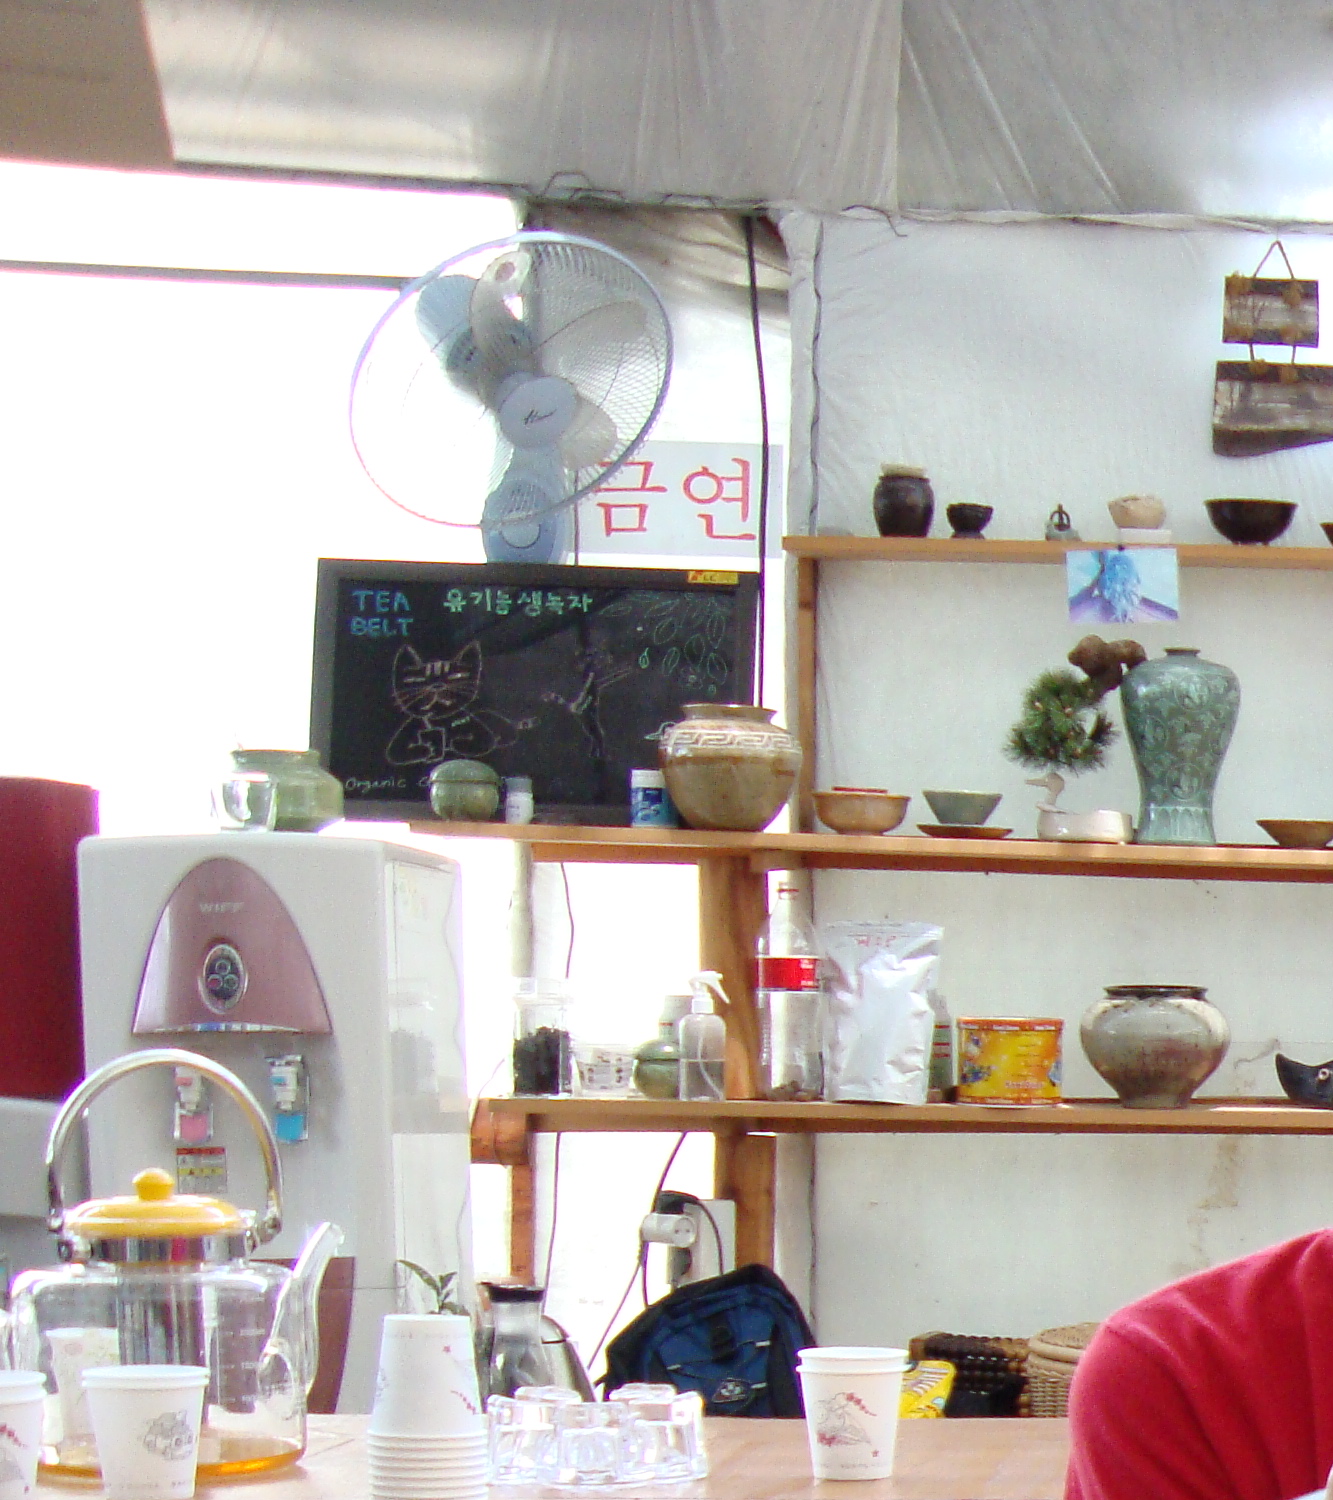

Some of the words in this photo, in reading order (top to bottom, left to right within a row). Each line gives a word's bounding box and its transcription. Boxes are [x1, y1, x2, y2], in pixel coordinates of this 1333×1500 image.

[591, 457, 757, 541] 금연
[351, 588, 412, 613] TEA
[349, 614, 415, 638] BELT
